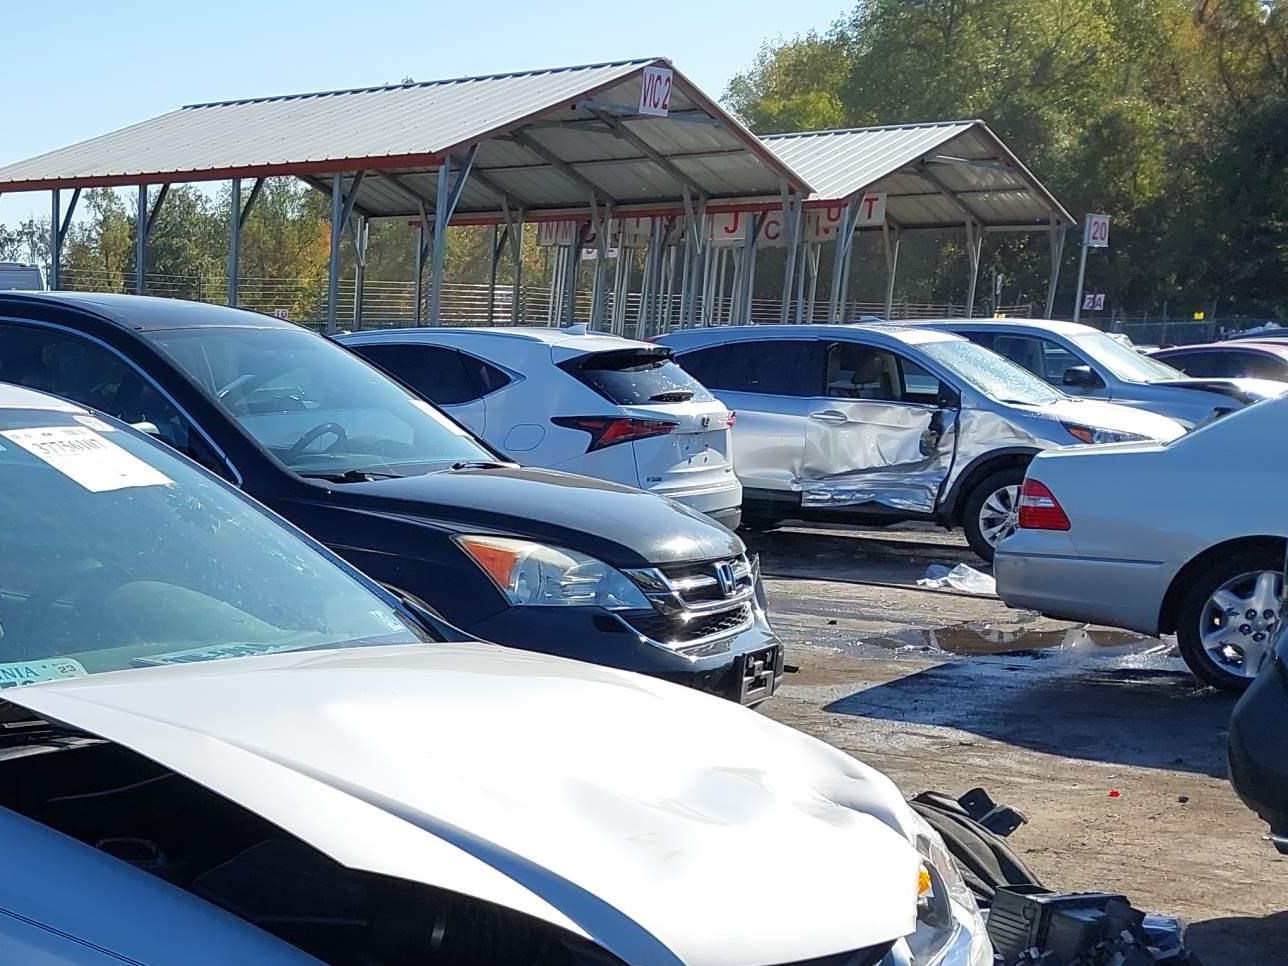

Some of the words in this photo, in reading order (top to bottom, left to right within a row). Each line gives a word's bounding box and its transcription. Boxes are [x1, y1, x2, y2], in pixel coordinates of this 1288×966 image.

[864, 197, 879, 220] T
[764, 220, 780, 240] C
[1091, 221, 1108, 241] 20
[58, 664, 76, 674] 23
